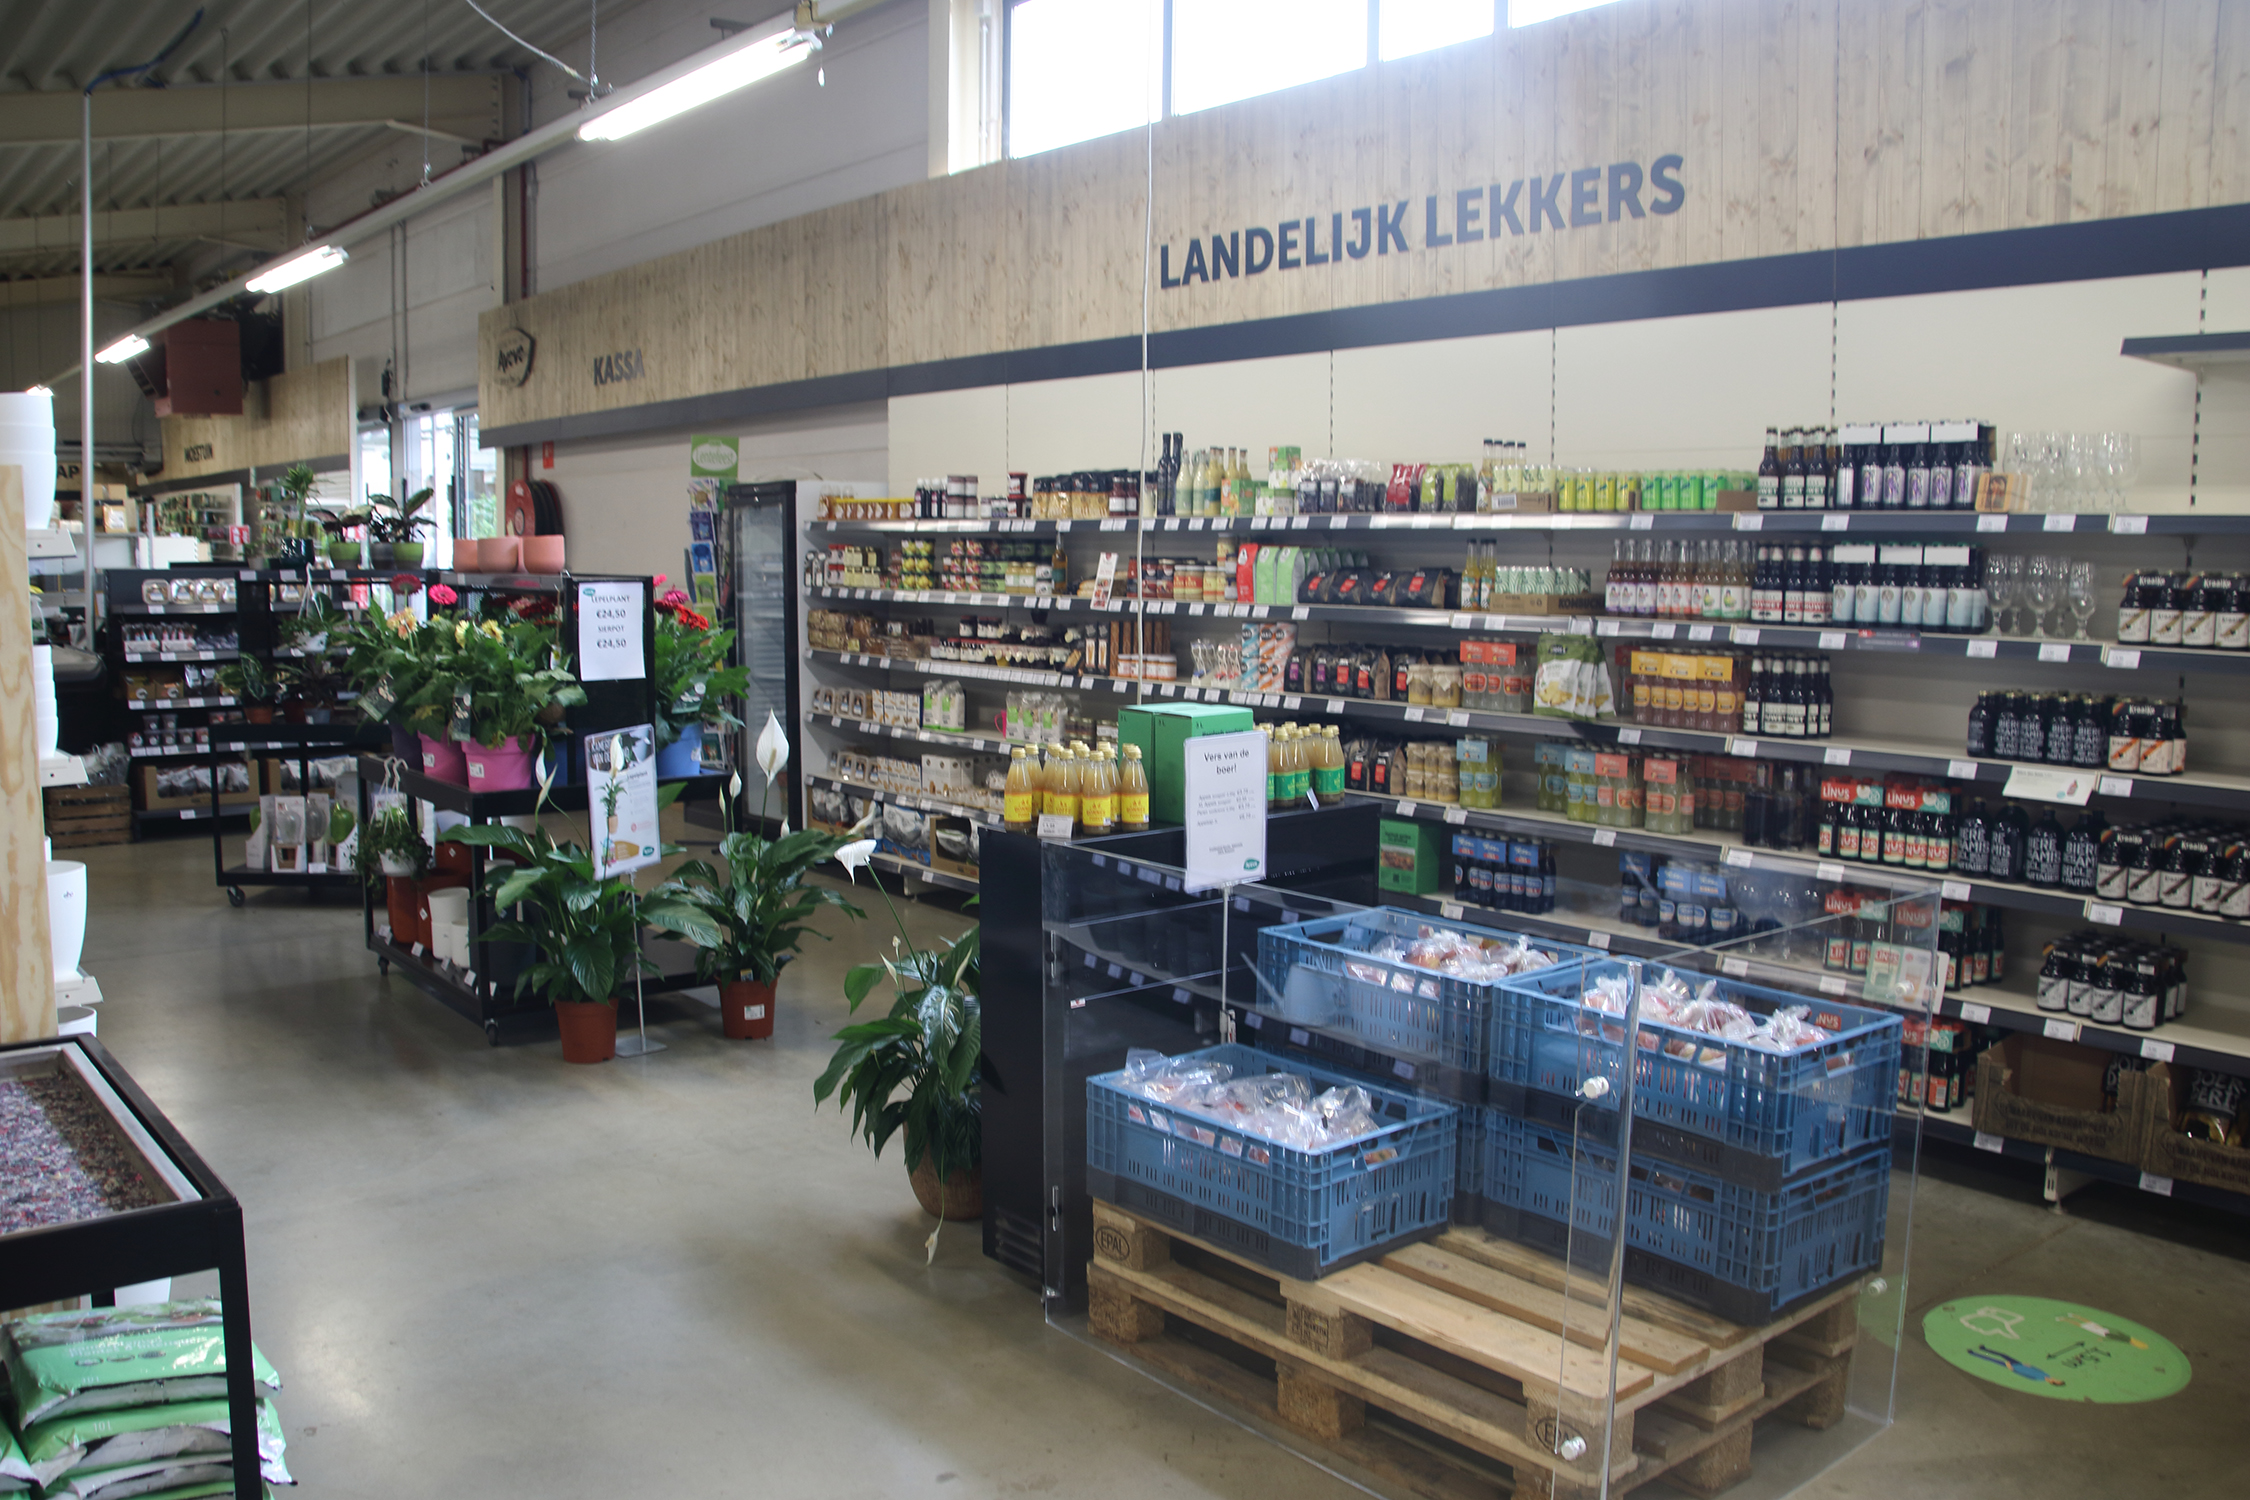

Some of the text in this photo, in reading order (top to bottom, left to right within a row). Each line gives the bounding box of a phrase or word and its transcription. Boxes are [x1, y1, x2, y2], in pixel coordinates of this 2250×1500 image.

[1160, 153, 1686, 290] LANDELIJK LEKKERS
[593, 348, 645, 387] KASSA
[1203, 748, 1250, 763] Vers van de
[1216, 764, 1237, 775] boer!
[1100, 1231, 1124, 1254] EPAL
